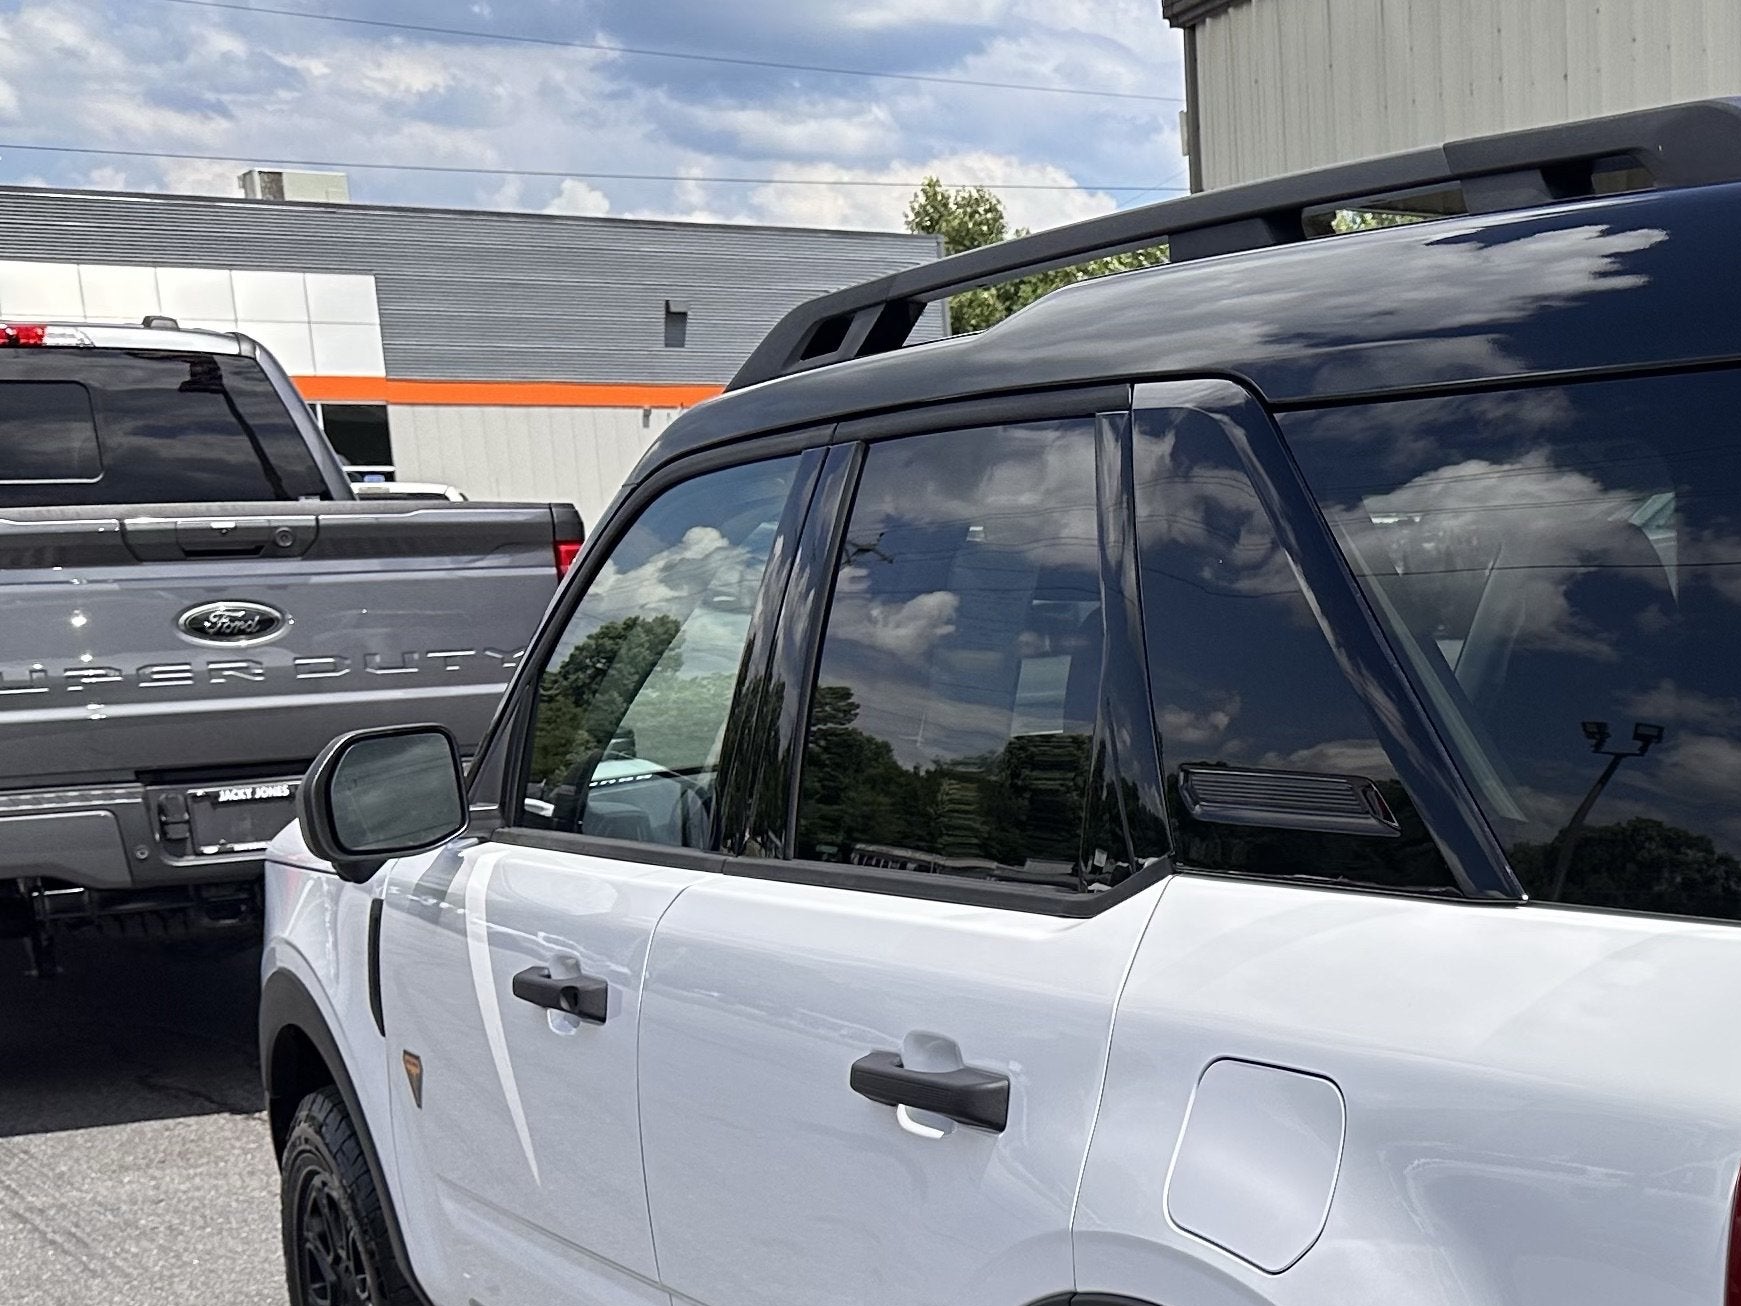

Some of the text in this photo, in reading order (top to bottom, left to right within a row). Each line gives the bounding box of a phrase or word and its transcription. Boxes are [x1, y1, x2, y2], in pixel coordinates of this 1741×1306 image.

[204, 609, 260, 634] Ford
[0, 646, 528, 695] UPER DUTY
